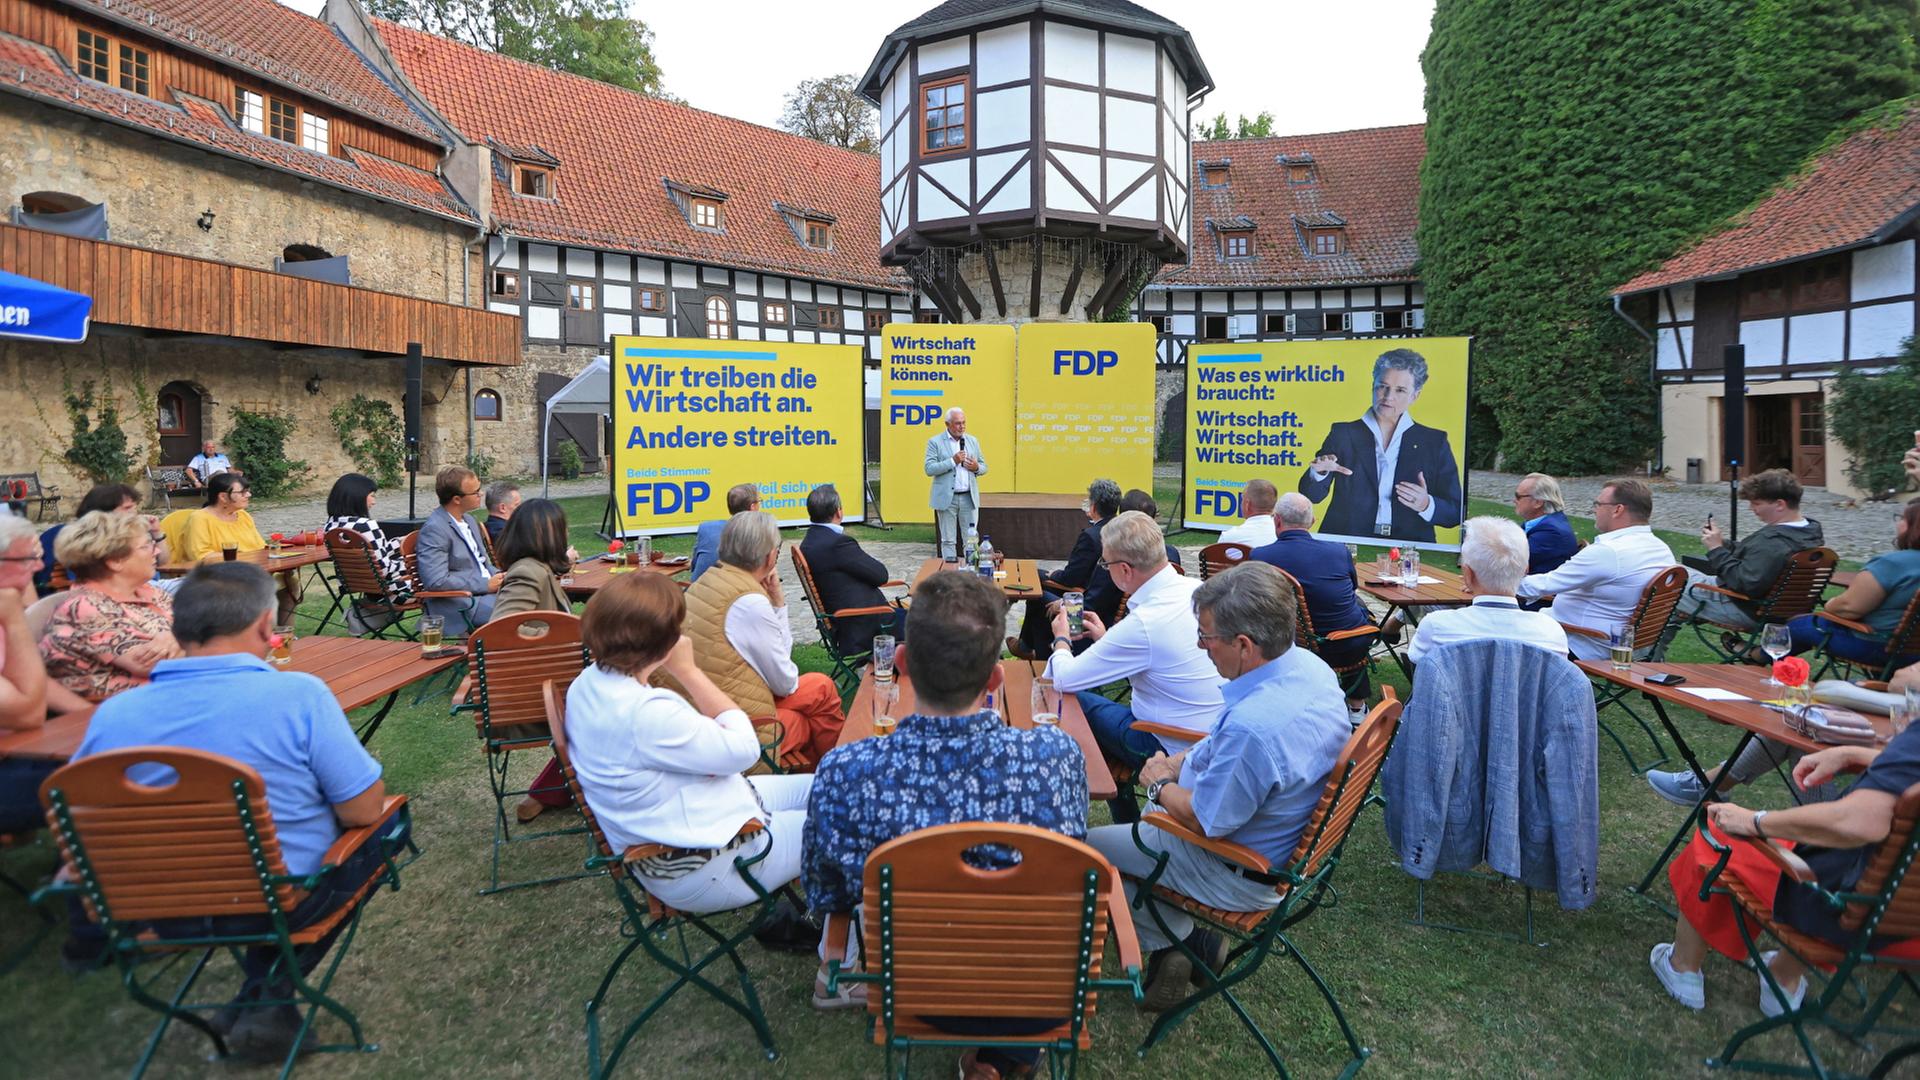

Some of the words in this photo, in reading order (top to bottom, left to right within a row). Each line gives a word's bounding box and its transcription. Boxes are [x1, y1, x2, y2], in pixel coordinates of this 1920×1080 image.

[891, 336, 976, 350] Wirtschaft
[890, 354, 933, 365] muss
[936, 355, 972, 366] man
[1053, 350, 1119, 376] FDP
[625, 363, 676, 387] Wir
[680, 365, 776, 389] treiben
[780, 367, 817, 390] die
[890, 366, 953, 382] können.
[1197, 366, 1237, 383] Was
[1239, 370, 1261, 383] es
[1265, 364, 1345, 383] wirklich
[625, 389, 772, 413] Wirtschaft
[776, 395, 813, 413] an.
[1196, 383, 1276, 401] braucht:
[889, 404, 943, 426] FDP
[1196, 410, 1304, 428] Wirtschaft.
[626, 425, 728, 449] Andere
[733, 424, 838, 448] streiten.
[1196, 428, 1303, 447] Wirtschaft.
[1195, 447, 1302, 467] Wirtschaft.
[626, 468, 658, 479] Beide
[660, 467, 711, 478] Stimmen:
[1195, 478, 1219, 487] Beide
[781, 480, 808, 493] sich
[626, 480, 711, 517] FDP
